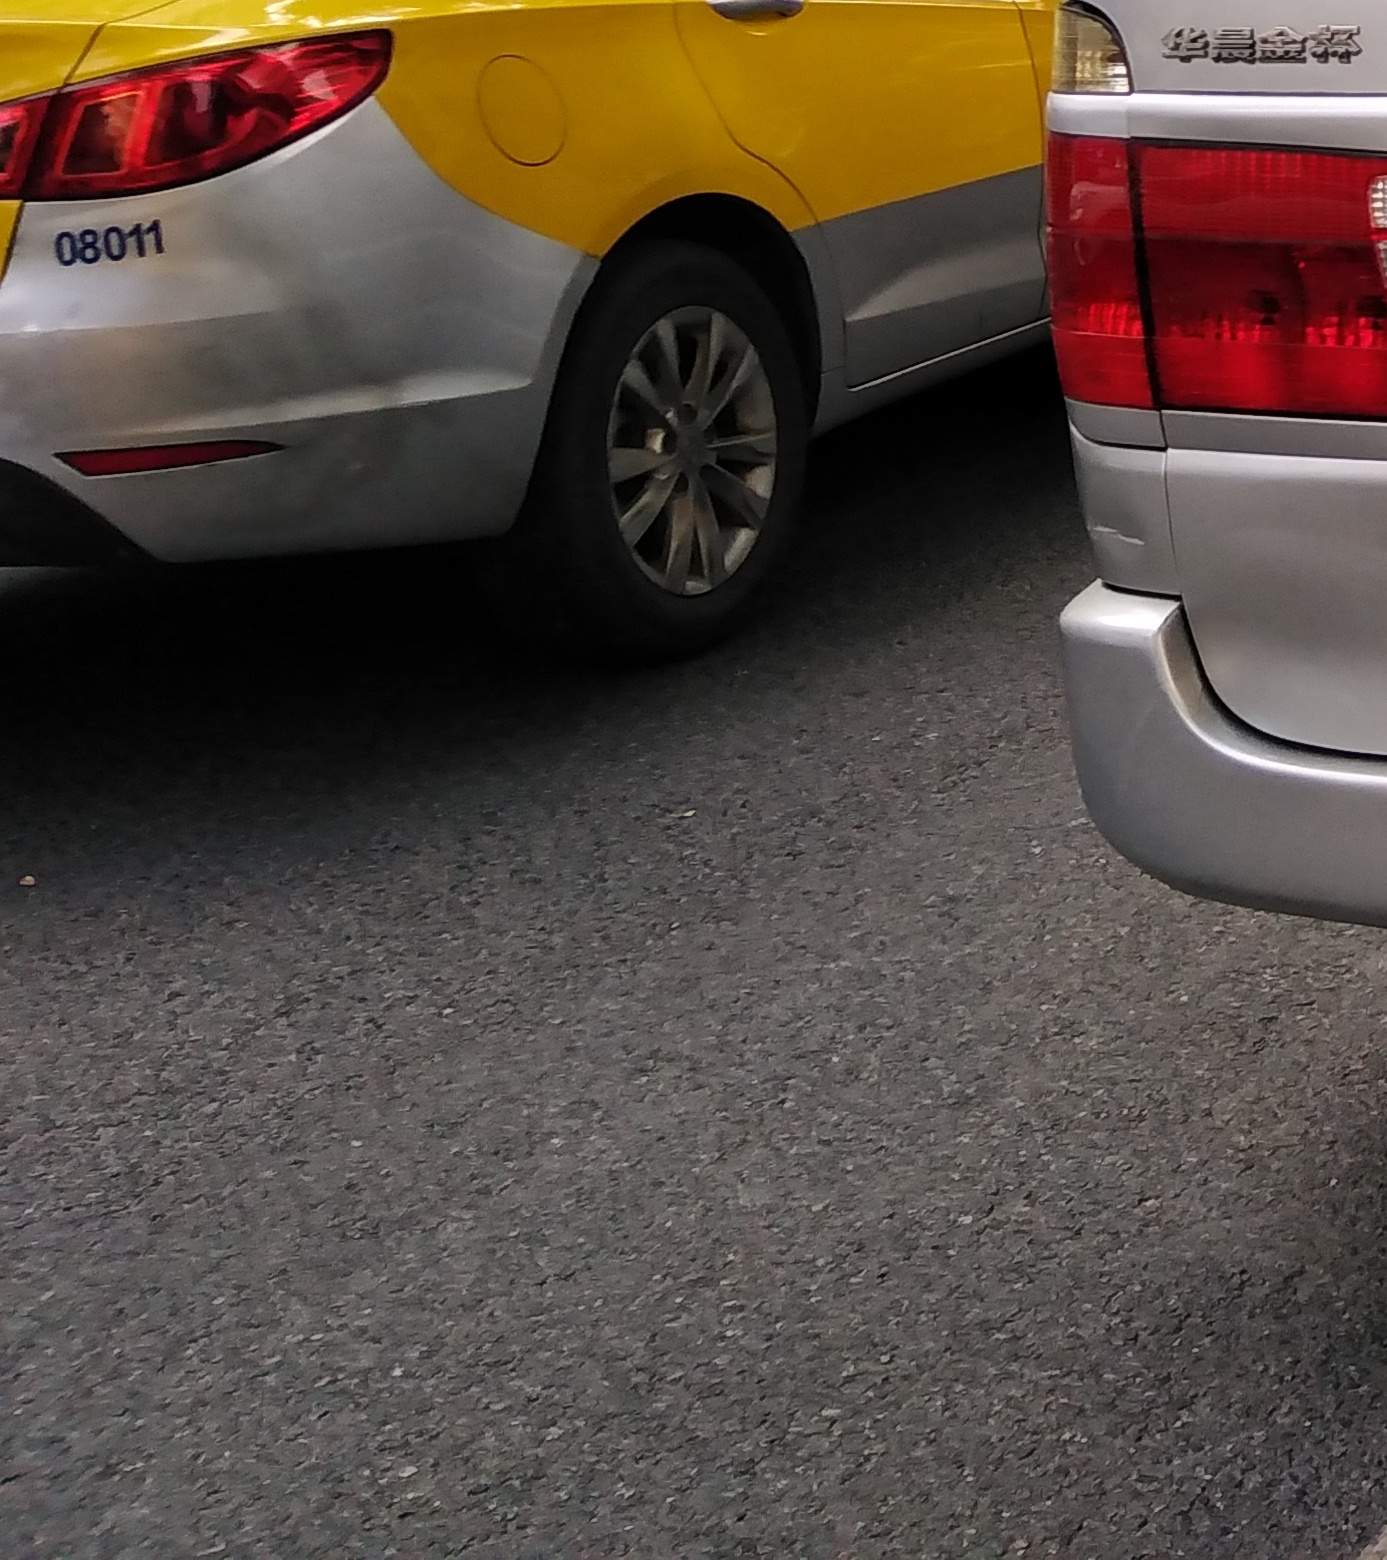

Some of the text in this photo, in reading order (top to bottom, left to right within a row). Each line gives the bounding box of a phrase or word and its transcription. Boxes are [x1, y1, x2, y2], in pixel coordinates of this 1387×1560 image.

[1161, 24, 1363, 64] 华晨金杯
[55, 219, 165, 267] 08011
